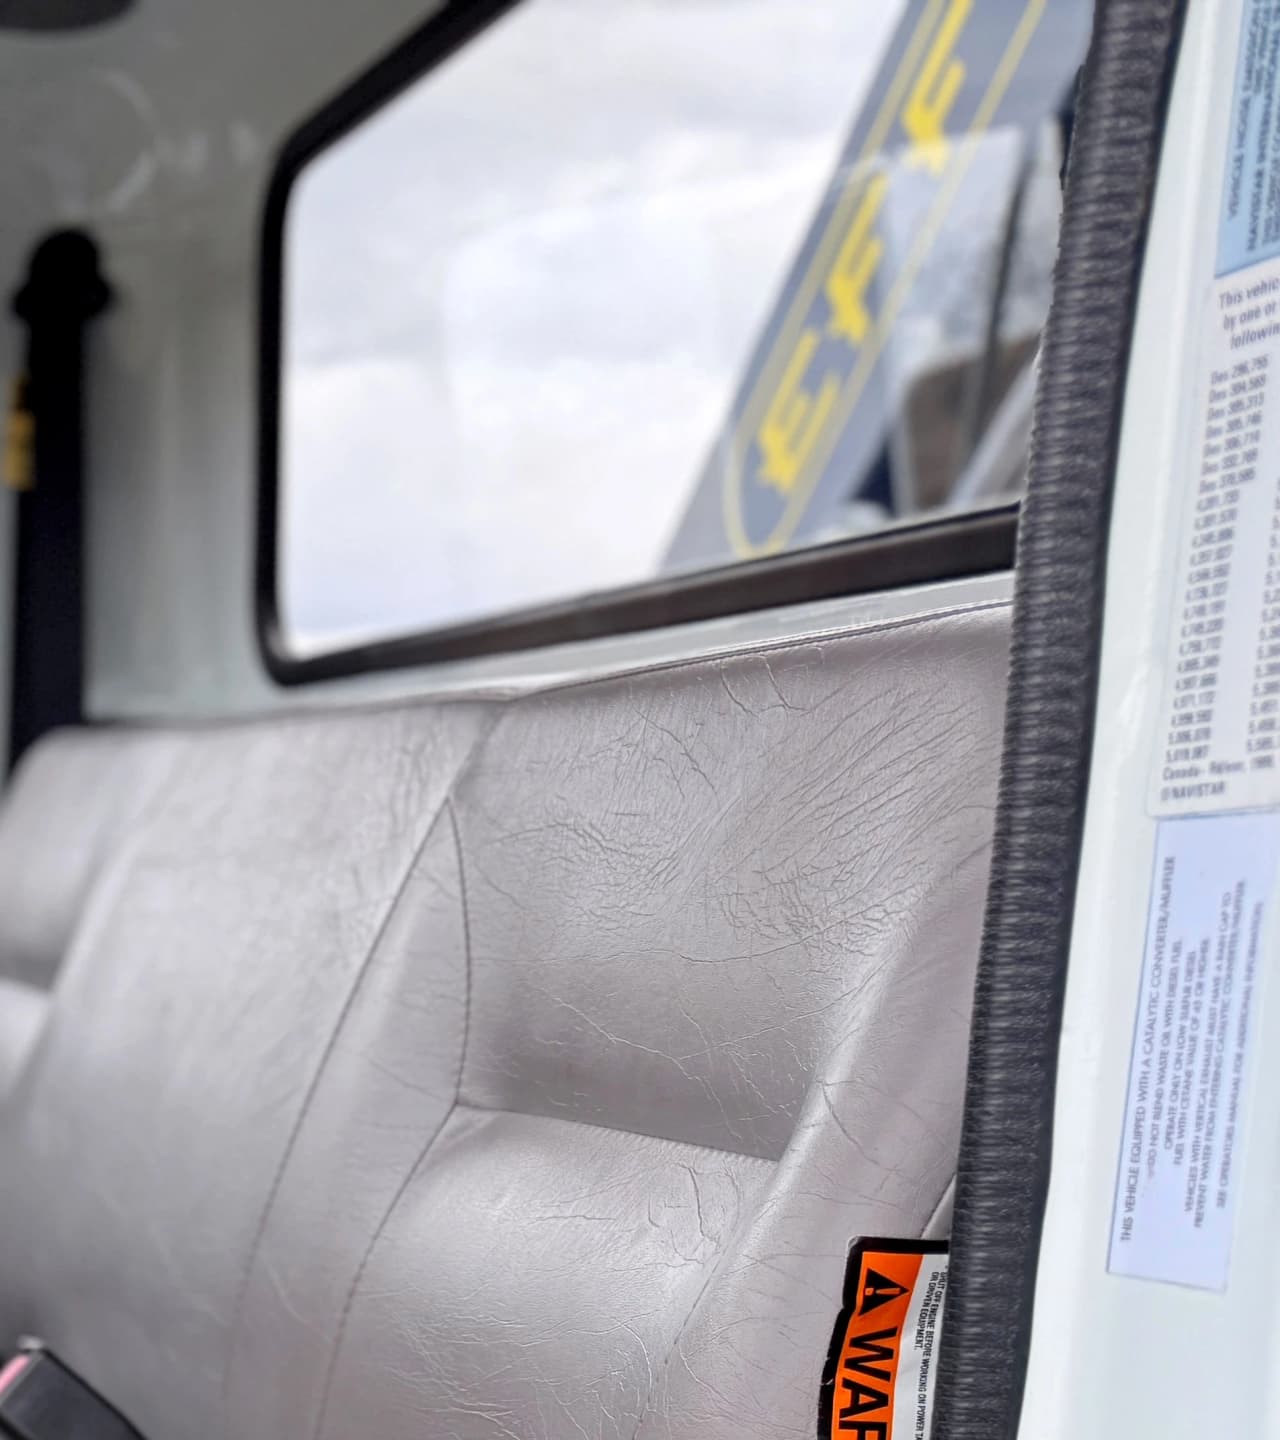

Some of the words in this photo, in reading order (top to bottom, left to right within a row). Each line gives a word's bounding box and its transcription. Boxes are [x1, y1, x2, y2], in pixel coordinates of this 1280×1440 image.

[1143, 991, 1159, 1055] CATALYTIC
[1137, 1071, 1150, 1101] WITH
[1130, 1106, 1146, 1164] EQUIPPED
[1125, 1167, 1139, 1213] VEHICLE
[1120, 1217, 1134, 1241] THIS
[930, 1272, 939, 1281] OR
[922, 1283, 936, 1307] DRIVEN
[914, 1308, 929, 1350] EQUIPMENT.
[927, 1304, 939, 1329] ENGINE
[923, 1330, 934, 1357] BEFORE
[918, 1359, 929, 1392] WORKING
[918, 1394, 927, 1404] ON
[916, 1406, 926, 1431] POWER
